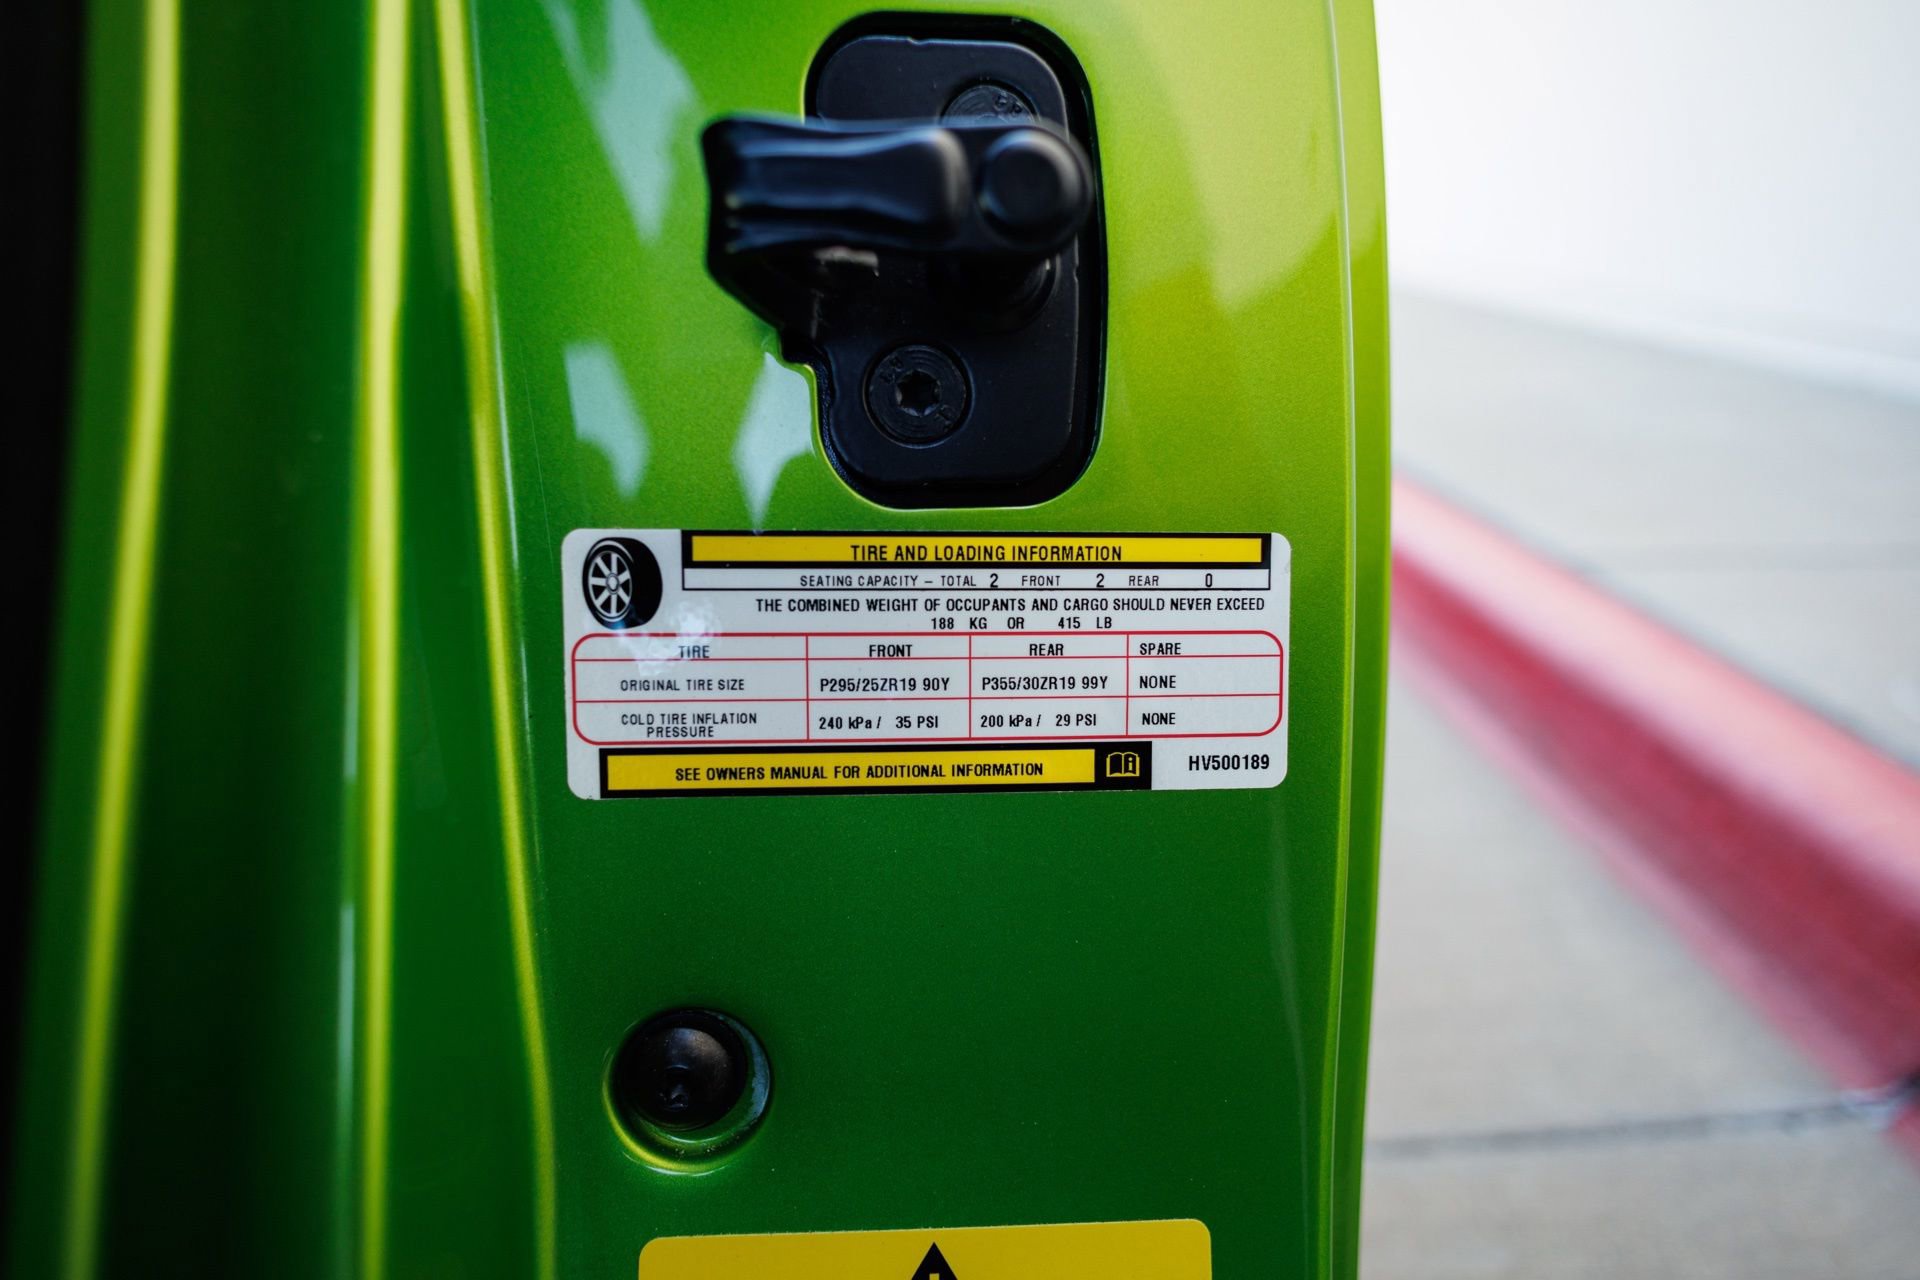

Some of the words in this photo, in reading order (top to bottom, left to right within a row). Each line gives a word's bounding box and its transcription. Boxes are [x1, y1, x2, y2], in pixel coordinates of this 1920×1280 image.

[850, 545, 889, 561] TIRE
[894, 545, 929, 561] AND
[934, 545, 1006, 561] LOADING
[1012, 545, 1122, 561] INFORMATION
[799, 575, 853, 587] SEATING
[857, 575, 919, 587] CAPACITY
[940, 575, 977, 587] TOTAL
[989, 573, 999, 588] 2
[1021, 575, 1061, 587] FRONT
[1096, 573, 1105, 588] 2
[1128, 575, 1159, 587] REAR
[1205, 573, 1214, 588] 0
[756, 598, 783, 612] THE
[788, 598, 860, 612] COMBINED
[866, 598, 918, 612] WEIGHT
[924, 598, 941, 611] OF
[946, 598, 1026, 611] OCCUPANTS
[1031, 598, 1058, 611] AND
[1063, 598, 1109, 611] CARGO
[1112, 598, 1165, 611] SHOULD
[1170, 598, 1212, 611] NEVER
[1216, 597, 1265, 611] EXCEED
[930, 617, 954, 630] 188
[969, 617, 988, 630] KG
[1006, 617, 1025, 630] OR
[1057, 617, 1081, 629] 415
[1096, 617, 1113, 629] LB
[678, 645, 710, 659] TIRE
[869, 644, 913, 658] FRONT
[1029, 643, 1064, 657] REAR
[1139, 642, 1181, 656] SPARE
[620, 679, 680, 692] ORIGINAL
[686, 679, 713, 691] TIRE
[717, 679, 745, 691] SIZE
[820, 678, 917, 693] P295/25ZR19
[922, 677, 950, 691] 90Y
[981, 676, 1076, 690] P355/30ZR19
[1081, 676, 1108, 690] 99Y
[1139, 675, 1176, 689] NONE
[620, 714, 655, 726] COLD
[660, 713, 687, 725] TIRE
[692, 713, 757, 725] INFLATION
[818, 717, 843, 730] 240
[848, 716, 872, 729] kPa
[895, 716, 912, 729] 35
[917, 716, 939, 729] PSI
[980, 715, 1004, 728] 200
[1009, 714, 1032, 728] kPa
[1055, 714, 1071, 727] 29
[1076, 713, 1097, 727] PSI
[1142, 712, 1176, 726] NONE
[646, 726, 715, 738] PRESSURE
[1188, 754, 1270, 772] HV500189
[675, 767, 701, 781] SEE
[706, 766, 765, 781] OWNERS
[770, 766, 828, 780] MANUAL
[834, 765, 860, 779] FOR
[866, 764, 946, 780] ADDITIONAL
[951, 762, 1043, 777] INFORMATION
